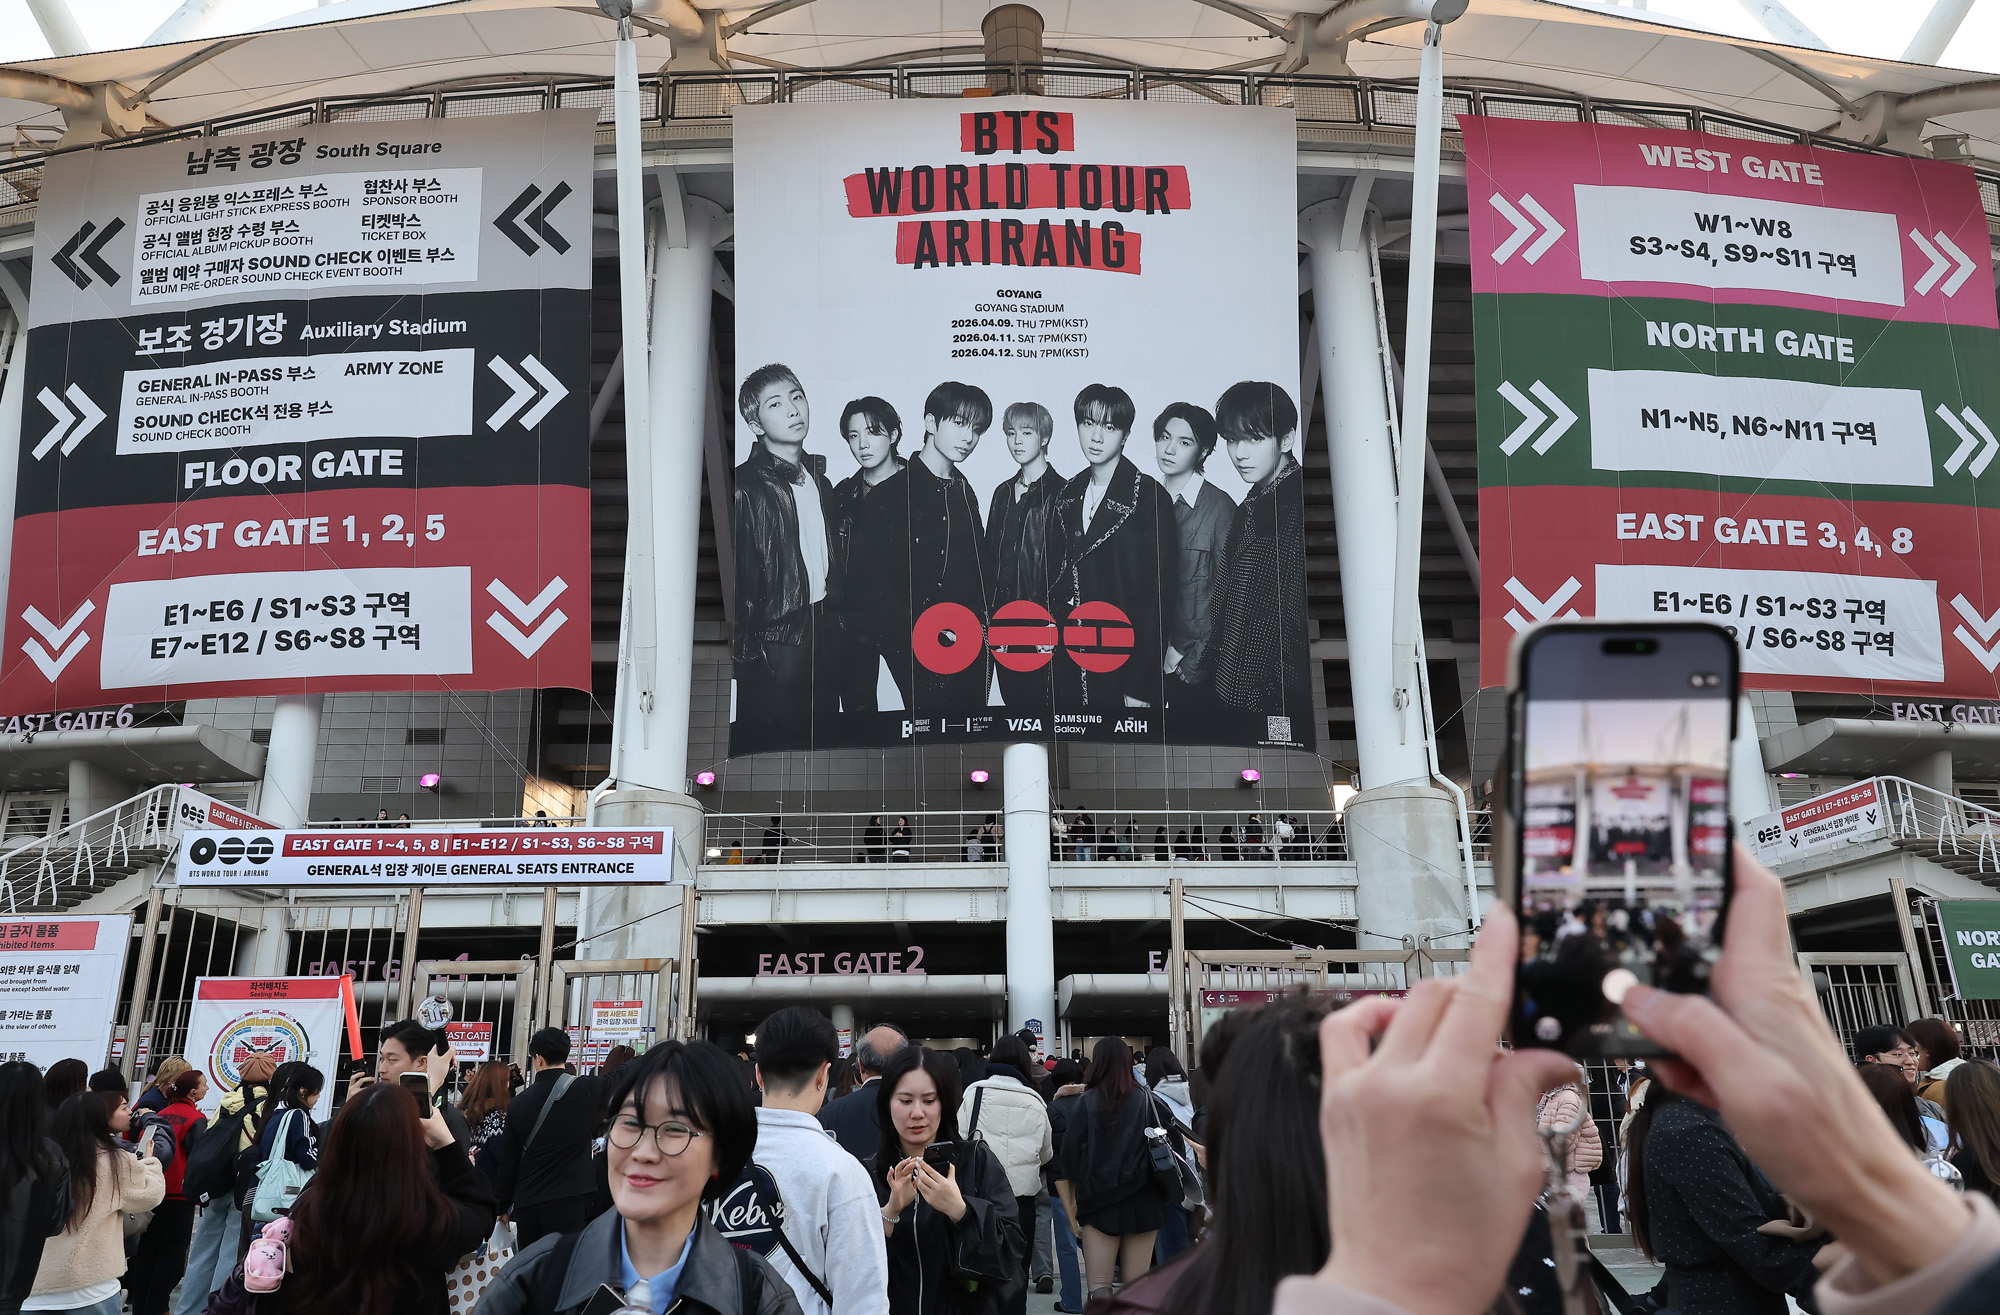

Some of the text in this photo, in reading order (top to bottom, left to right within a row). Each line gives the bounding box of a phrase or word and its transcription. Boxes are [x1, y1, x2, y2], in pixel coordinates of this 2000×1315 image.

[974, 110, 1059, 155] BTS
[187, 137, 307, 176] 남측 광장
[316, 141, 442, 159] South Square
[1638, 143, 1824, 186] WEST GATE
[364, 177, 442, 195] 협찬사 부스
[864, 162, 1171, 215] WORLD TOUR
[146, 183, 328, 216] 공식 응원봉 익스프레스 부스
[362, 194, 458, 207] SPONSOR BOOTH
[144, 198, 350, 227] OFFICIAL LIGHT STICK EXPRESS BOOTH
[361, 213, 421, 230] 티켓박스
[142, 219, 300, 250] 공식 앨범 현장 수령 부스
[361, 230, 427, 241] TICKET BOX
[1694, 211, 1793, 240] W1~W8
[141, 236, 313, 262] OFFICIAL ALBUM PICKUP BOOTH
[914, 217, 1125, 270] ARIRANG
[140, 247, 456, 285] 앨범 예약 구매자 SOUND CHECK 이벤트 부스
[1630, 235, 1858, 278] S3~S4, S9~S11 구역
[138, 266, 403, 297] ALBUM PRE-ORDER SOUND CHECK EVENT BOOTH
[996, 289, 1042, 299] GOYANG
[974, 303, 1065, 314] GOYANG STADIUM
[134, 312, 287, 356] 보조 경기장
[300, 318, 467, 341] Auxiliary Stadium
[951, 318, 1089, 329] 2026.04.09. THU 7PM(KST)
[952, 333, 1087, 344] 2026.04.11. SAT 7PM(KST)
[1645, 320, 1855, 364] NORTH GATE
[951, 347, 1089, 359] 2026.04.12. SUN 7PM(KST)
[343, 360, 444, 377] ARMY ZONE
[137, 366, 316, 394] GENERAL IN-PASS 부스
[135, 385, 269, 407] GENERAL IN-PASS BOOTH
[133, 413, 194, 430] SOUND
[273, 402, 304, 420] 전용
[307, 400, 334, 418] 부스
[132, 424, 251, 444] SOUND CHECK BOOTH
[1641, 408, 1877, 446] N1~N5, N6~N11 구역
[184, 448, 403, 490] FLOOR GATE
[137, 513, 446, 557] EAST GATE 1, 2, 5
[1616, 512, 1914, 559] EAST GATE 3, 4, 8
[164, 591, 410, 627] E1~E6 S1~S3 구역
[1653, 591, 1887, 625] E1~E6 S1~S3 구역
[150, 623, 420, 660] E7~E12 S6~S8 구역
[1762, 626, 1847, 653] S6~S8
[1851, 630, 1895, 657] 구역
[1054, 714, 1102, 724] SAMSUNG
[1891, 702, 1944, 722] EAST
[1005, 718, 1043, 732] VISA
[1054, 725, 1086, 736] Galaxy
[1785, 807, 1816, 824] EAST GATE
[292, 835, 654, 853] EAST GATE 1~4, 5, 8 E1~E12 S1~S3, S6~S8 구역
[189, 869, 269, 878] BTS WORLD TOUR ARIRANG
[385, 863, 410, 877] 입장
[411, 863, 448, 877] 게이트
[451, 863, 513, 876] GENERAL
[516, 863, 558, 875] SEATS
[561, 862, 635, 874] ENTRANCE
[10, 924, 59, 938] 금지 물품
[1956, 930, 2000, 946] NOR
[30, 941, 55, 949] Items
[18, 964, 80, 975] 외부 음식물 일체
[758, 953, 825, 975] EAST
[1971, 952, 2000, 968] GA
[249, 981, 289, 990] 좌석배치도
[8, 1009, 53, 1020] 가리는 물품
[466, 1031, 490, 1040] GATE
